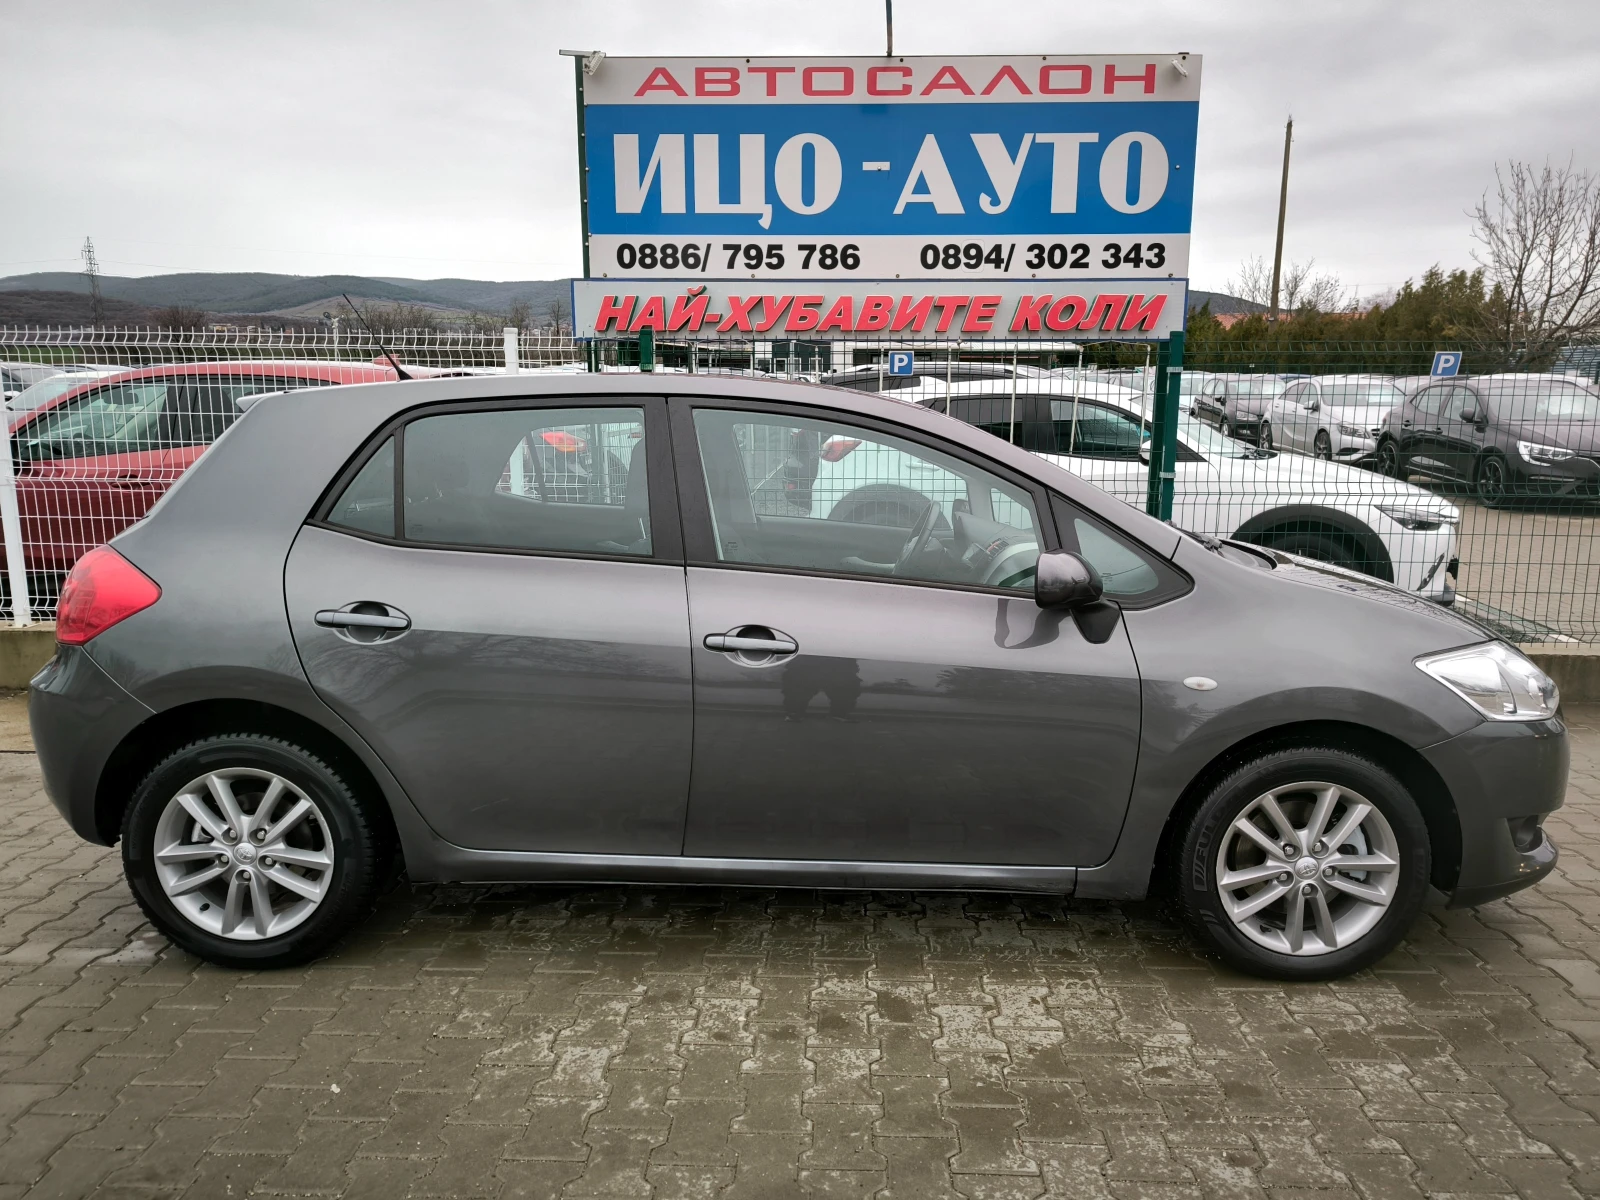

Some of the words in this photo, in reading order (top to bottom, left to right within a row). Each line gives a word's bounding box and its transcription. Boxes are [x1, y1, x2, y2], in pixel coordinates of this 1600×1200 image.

[635, 64, 1157, 98] АВТОСАЛОН
[613, 132, 843, 230] ИЦО
[616, 243, 713, 273] 0886/
[722, 243, 785, 270] 795
[797, 243, 861, 270] 786
[920, 243, 1016, 273] 0894/
[1025, 243, 1091, 270] 302
[1101, 242, 1166, 270] 343
[594, 285, 1003, 333] НАЙ-ХУБАВИТЕ
[1011, 293, 1168, 332] КОЛИ
[893, 354, 909, 373] P
[1436, 355, 1455, 374] P
